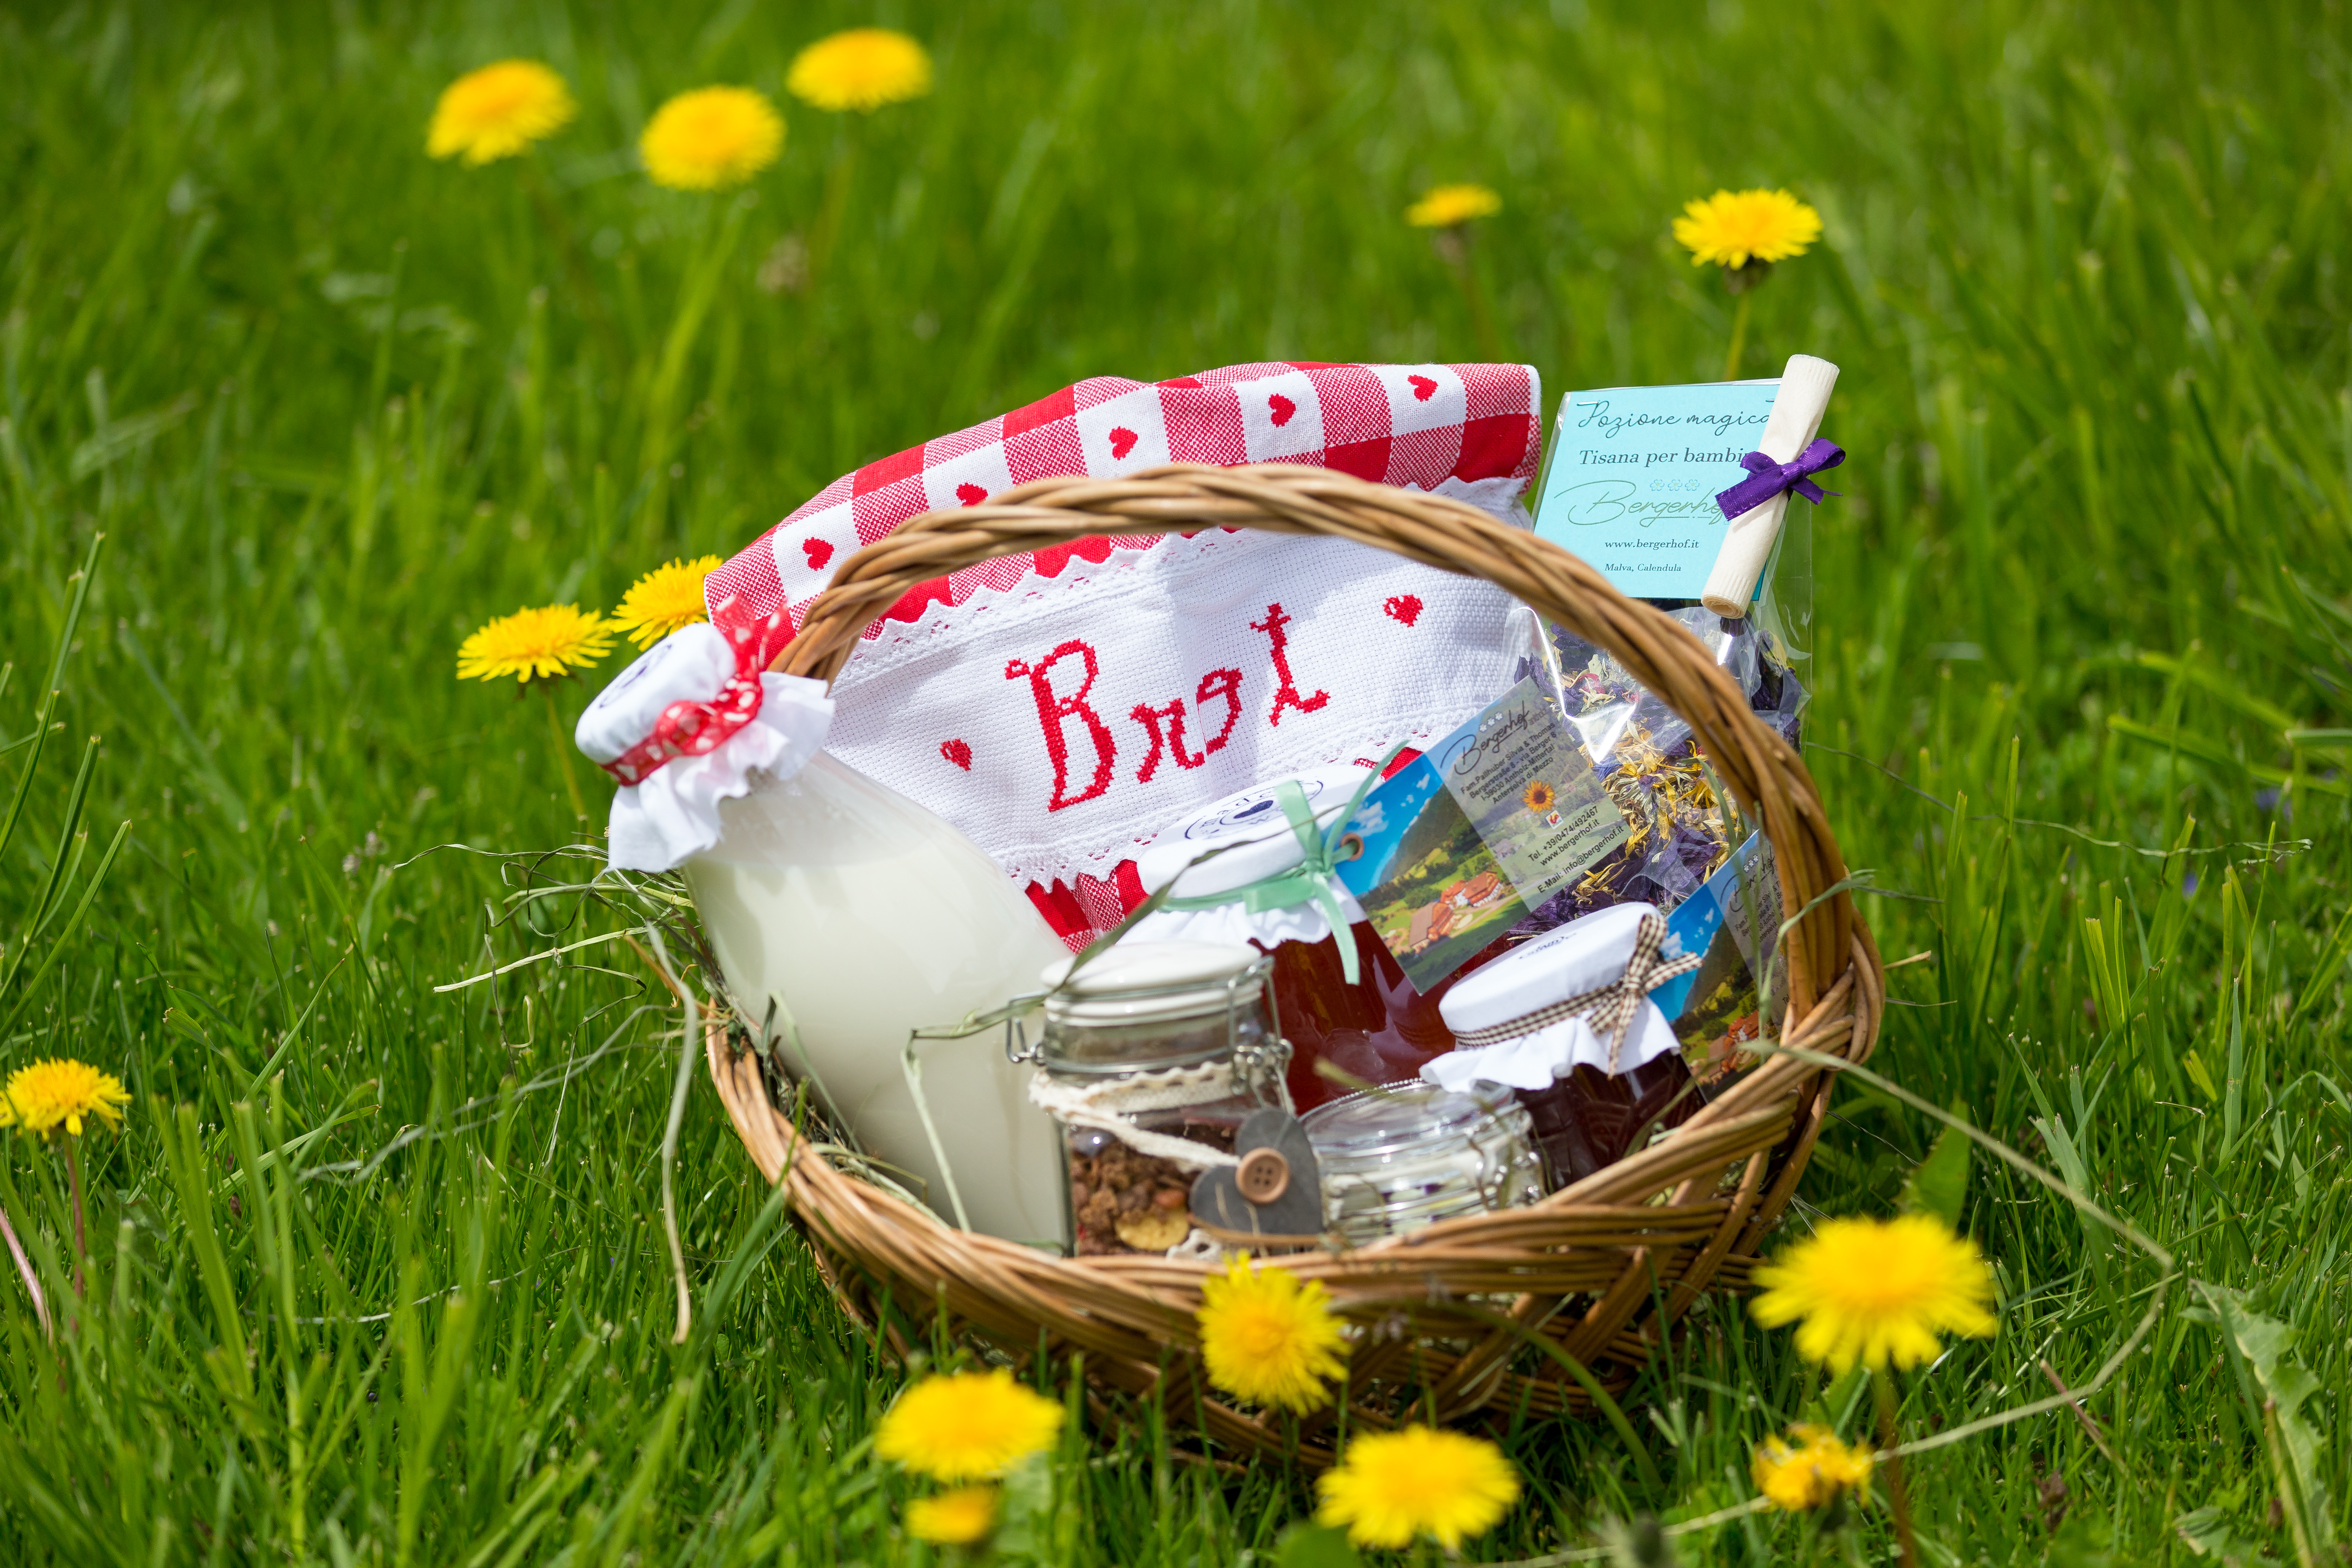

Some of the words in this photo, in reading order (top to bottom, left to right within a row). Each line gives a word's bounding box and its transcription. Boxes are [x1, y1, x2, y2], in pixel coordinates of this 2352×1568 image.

[1578, 401, 1681, 438] Pozione
[1579, 450, 1639, 465] Tisana
[1644, 451, 1678, 468] per
[1684, 447, 1743, 462] bambi
[1605, 539, 1700, 551] www.bergerhof.it
[1605, 563, 1634, 573] Malva,
[1637, 563, 1681, 572] Calendula
[1440, 700, 1529, 775] Bergerhof
[1505, 746, 1524, 760] Silvia
[1529, 723, 1555, 742] Thomas
[1519, 752, 1529, 761] via
[1529, 736, 1551, 754] Berger
[1493, 777, 1526, 804] Anterselva
[1526, 770, 1534, 779] di
[1533, 757, 1553, 773] Mezzo
[1528, 850, 1543, 861] Tel.
[1543, 806, 1598, 851] +39/0474/492467
[1540, 819, 1600, 866] www.bergerhof.it
[1537, 872, 1563, 893] E-Mail:
[1563, 825, 1624, 874] info@bergerhof.it
